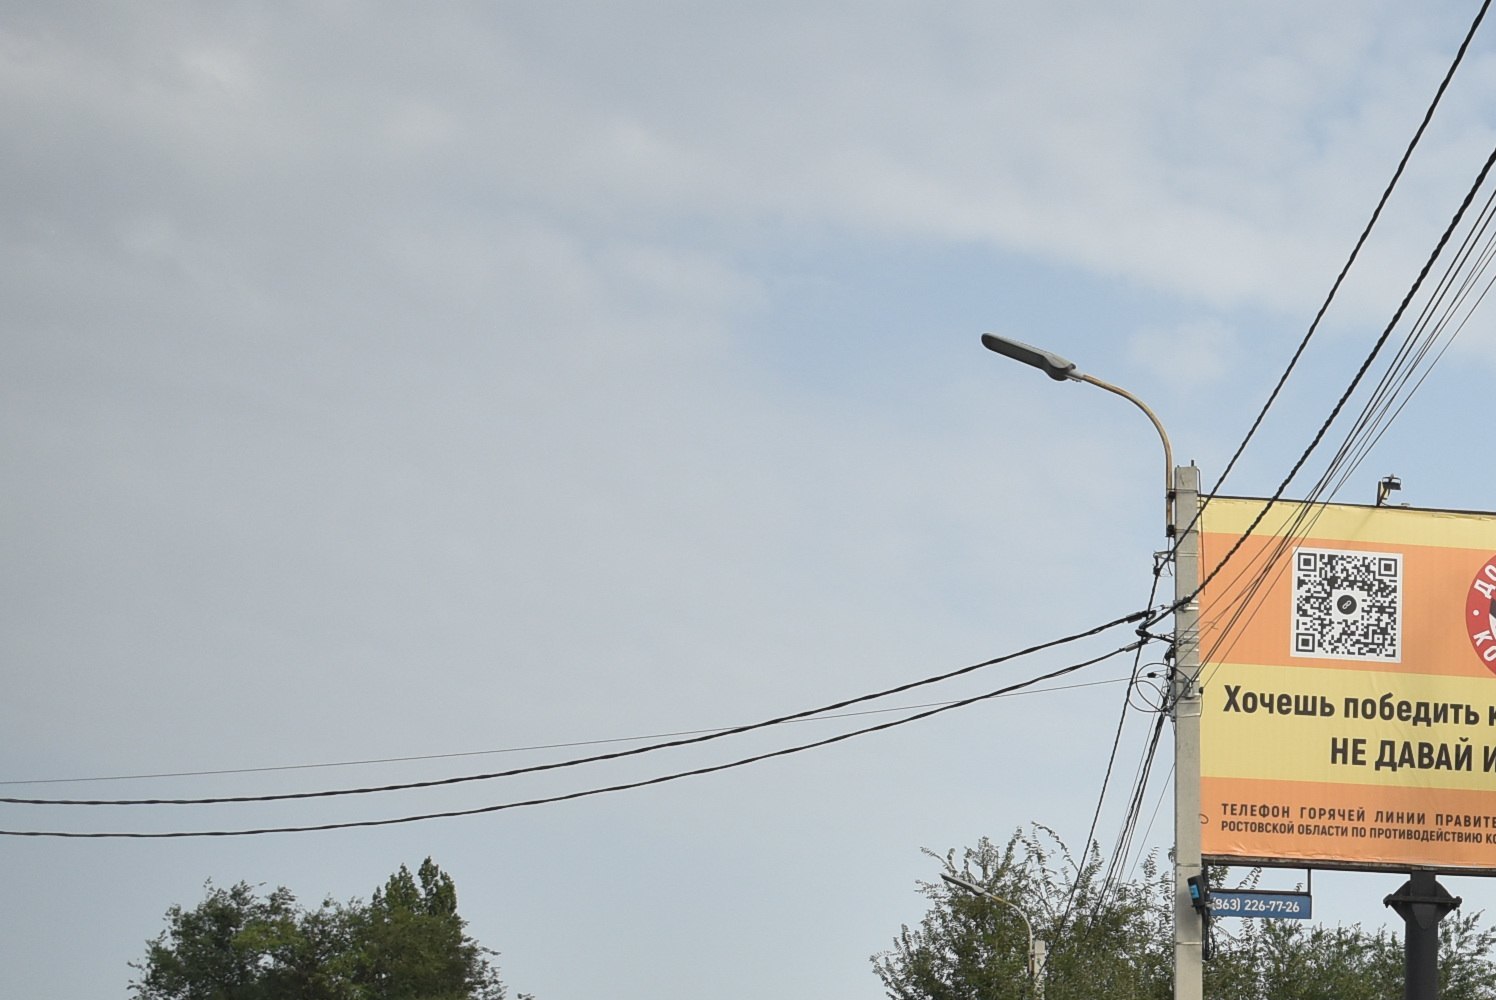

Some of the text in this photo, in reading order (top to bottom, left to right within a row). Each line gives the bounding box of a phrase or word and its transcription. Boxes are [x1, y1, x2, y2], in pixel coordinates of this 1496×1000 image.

[1223, 684, 1336, 717] Хочешь
[1343, 692, 1480, 728] победить
[1330, 737, 1367, 766] НЕ
[1374, 736, 1473, 773] ДАВАЙ
[1221, 803, 1290, 818] ТЕЛЕФОН
[1300, 806, 1365, 822] ГОРЯЧЕЙ
[1374, 810, 1426, 825] ЛИНИИ
[1221, 820, 1294, 834] РОСТОВСКОЙ
[1297, 823, 1348, 837] ОБЛАСТИ
[1352, 826, 1366, 838] ПО
[1369, 827, 1482, 843] ПРОТИВОДЕЙСТВИЮ
[1212, 897, 1300, 912] (863) 226-77-26
